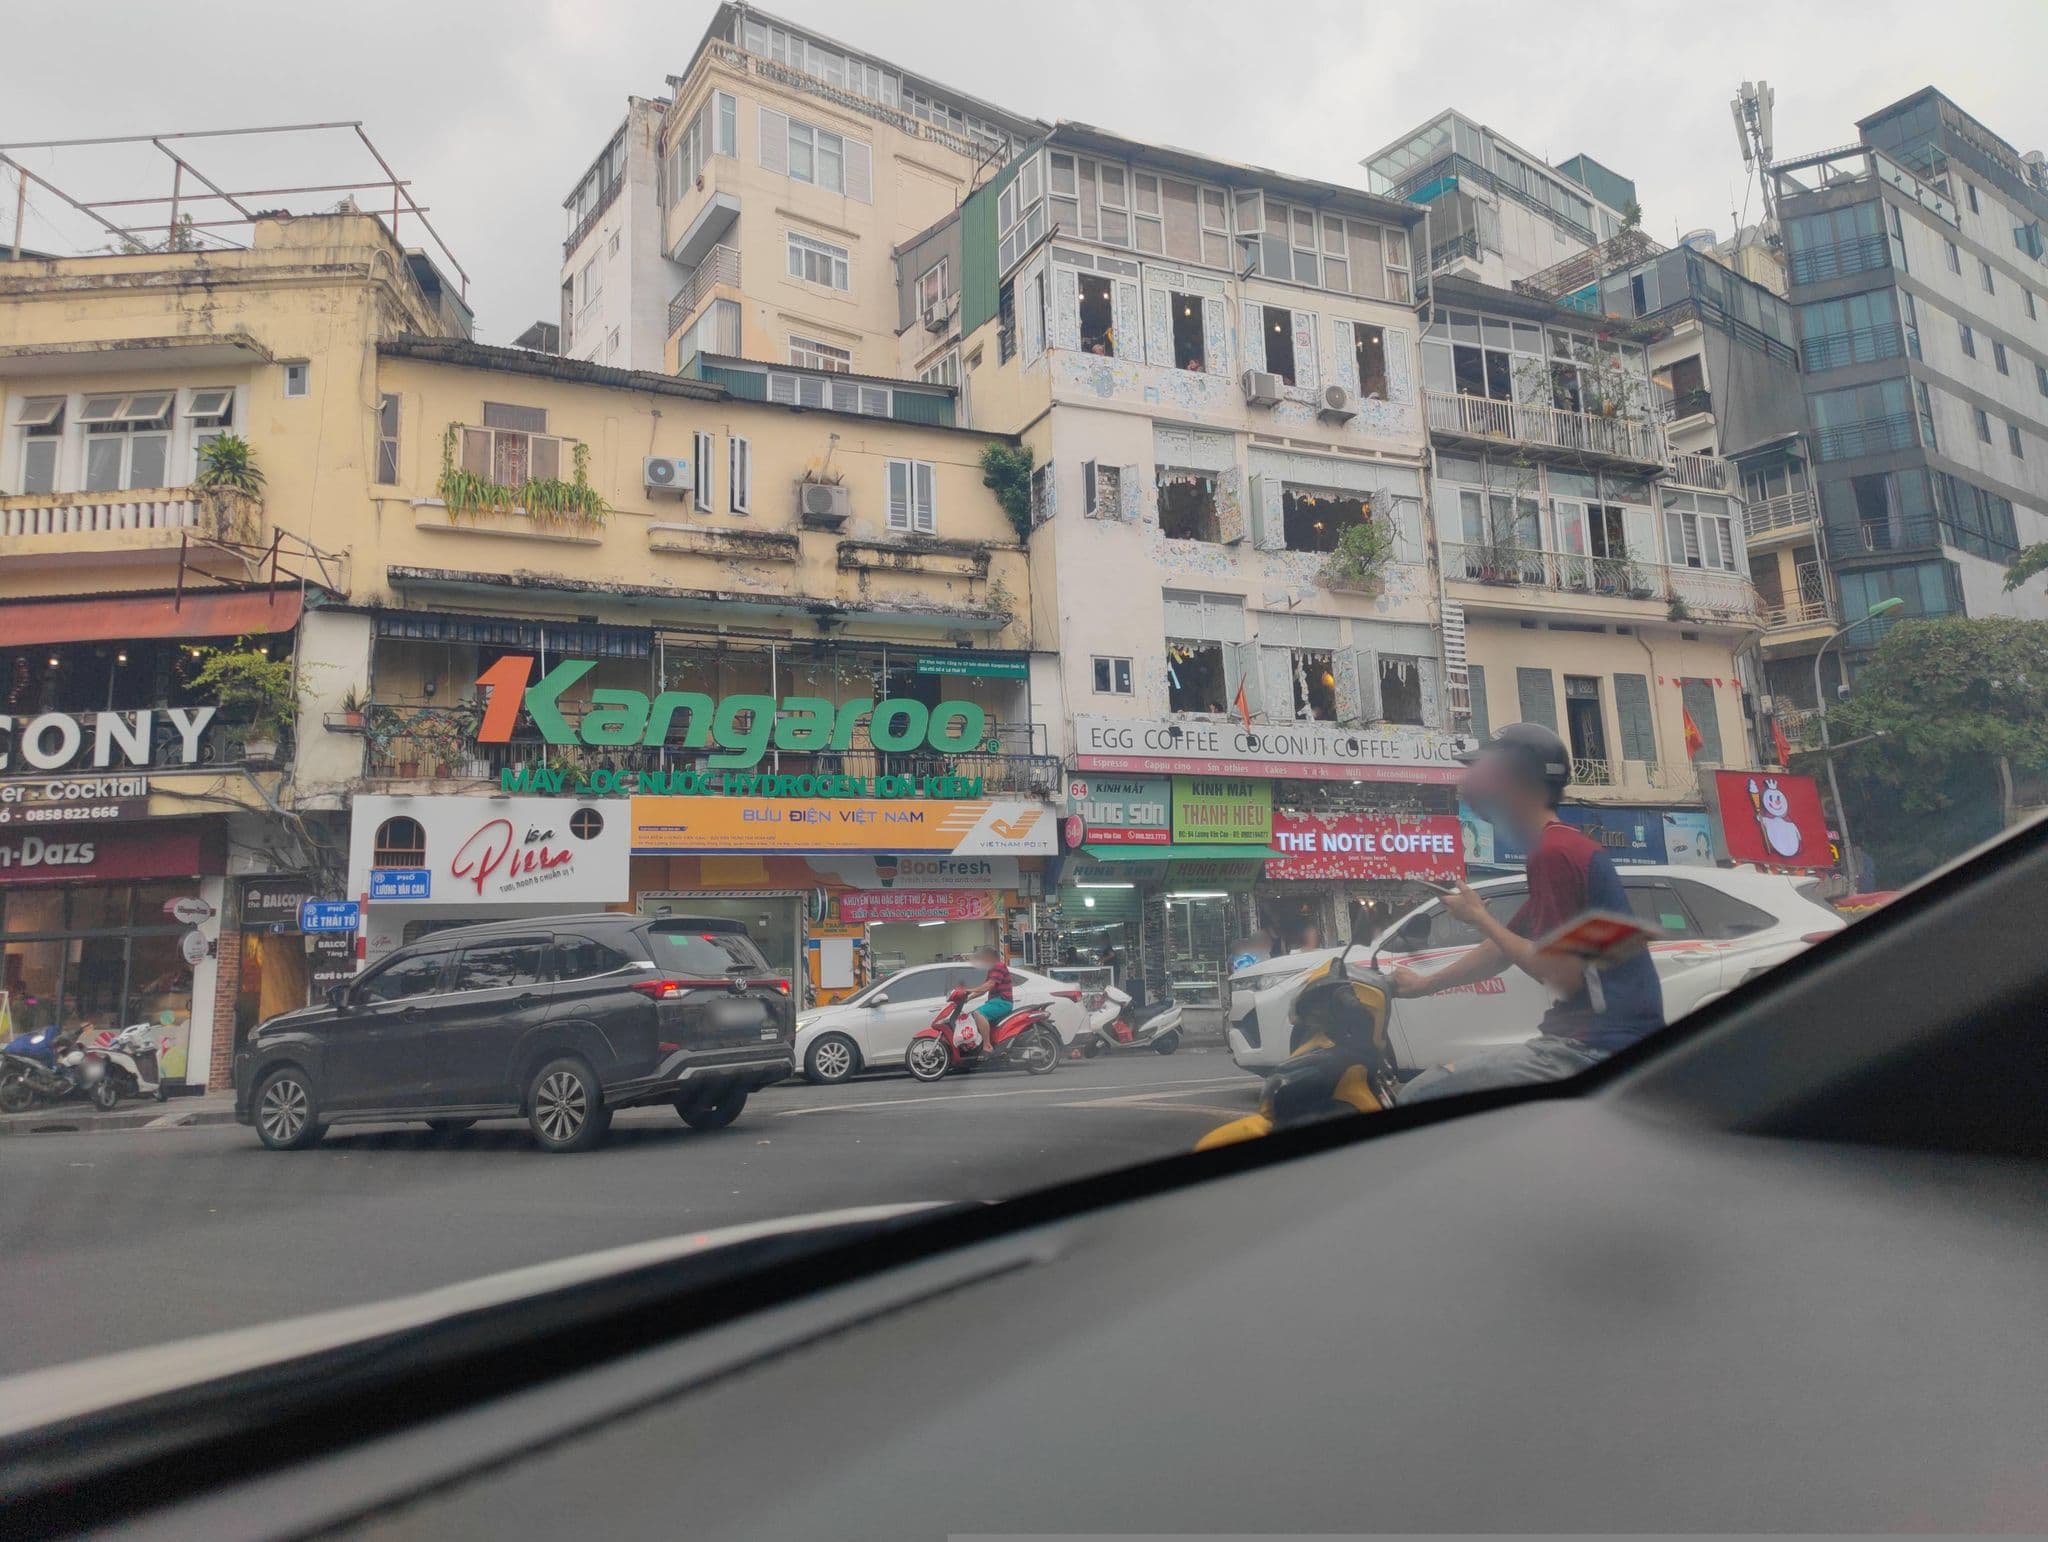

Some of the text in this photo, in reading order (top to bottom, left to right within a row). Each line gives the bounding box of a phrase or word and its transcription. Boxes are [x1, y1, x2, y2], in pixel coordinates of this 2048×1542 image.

[1091, 728, 1133, 748] EGG
[1144, 729, 1219, 751] COFFEE
[1234, 733, 1326, 756] COCONUT
[1334, 738, 1400, 759] COFFEE
[1092, 757, 1129, 769] Espresso
[502, 761, 568, 793] MÁY
[638, 764, 716, 795] NƯỚC
[723, 773, 867, 797] HYDROGEN
[875, 774, 917, 797] ION
[46, 776, 149, 800] Cocktail
[1071, 783, 1087, 796] 64
[742, 805, 924, 824] BƯU ĐIỆN VIỆT NAM
[1276, 832, 1455, 853] THE NOTE COFFEE
[900, 858, 991, 875] BooFresh
[411, 884, 425, 895] CAN
[263, 894, 303, 908] BALCON
[307, 915, 318, 927] LÊ
[320, 915, 342, 927] THÁI
